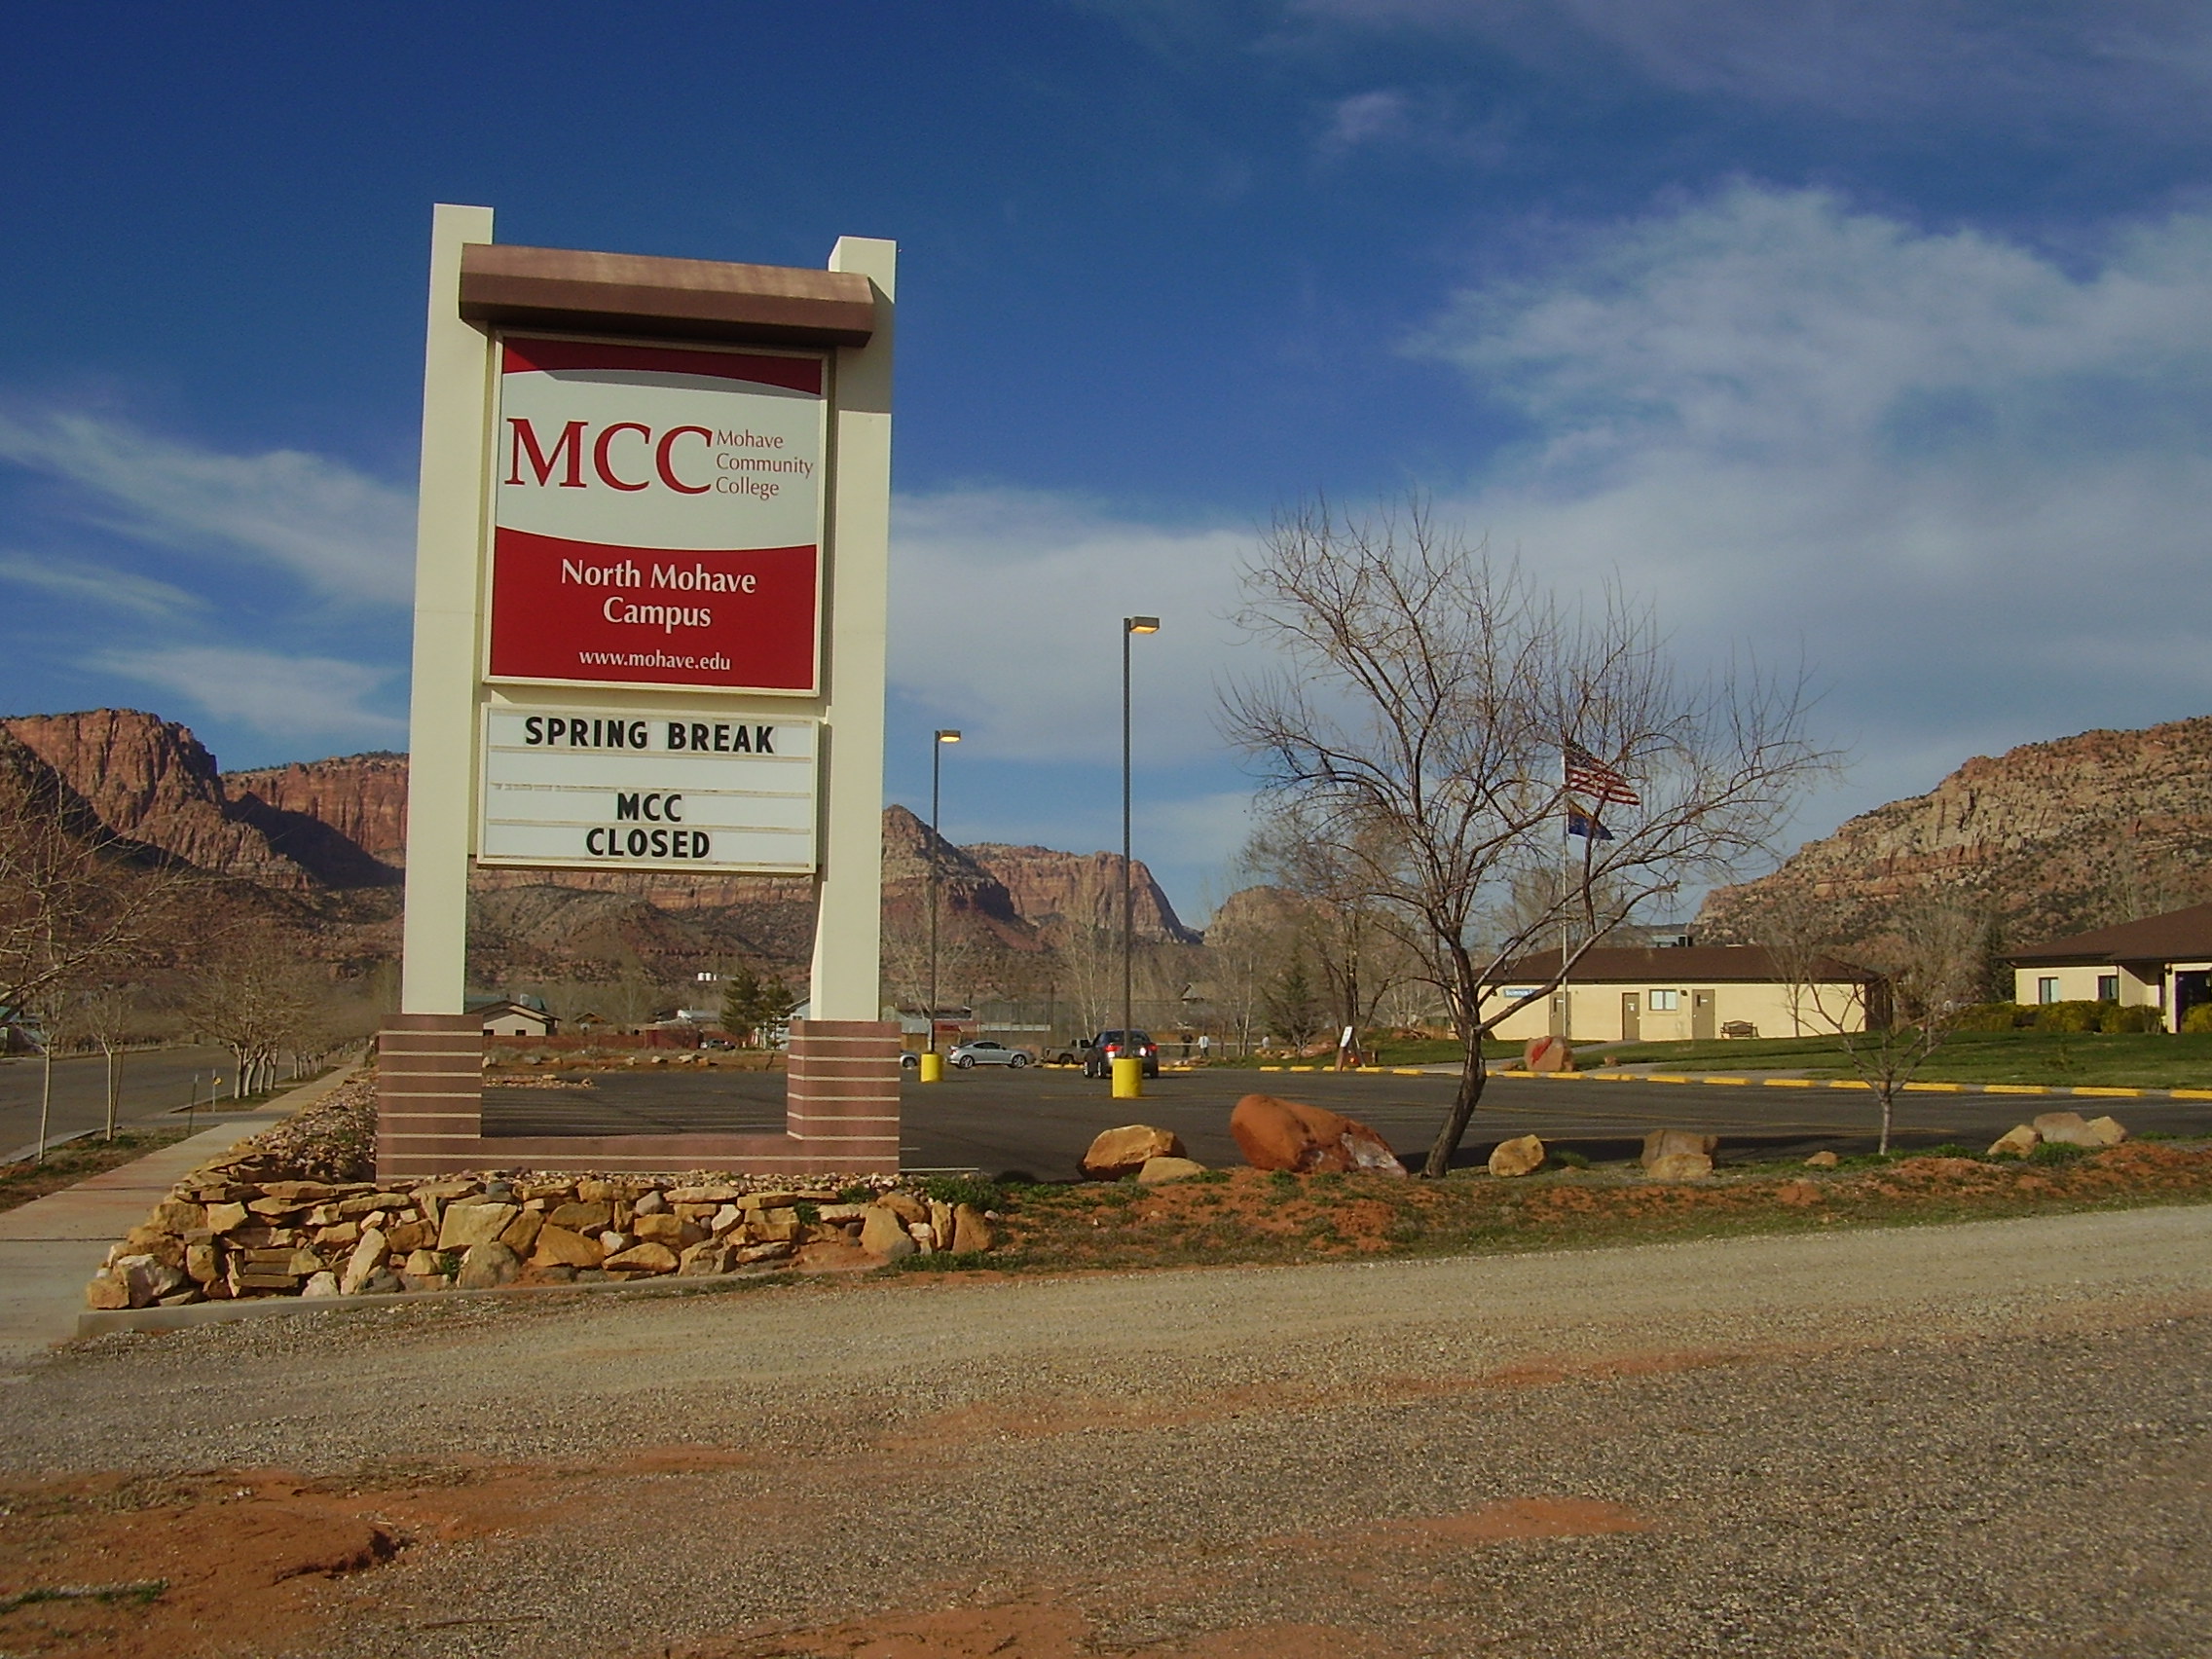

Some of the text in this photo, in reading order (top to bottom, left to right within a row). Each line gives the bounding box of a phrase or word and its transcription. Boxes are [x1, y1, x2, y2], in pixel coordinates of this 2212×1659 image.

[716, 429, 785, 450] Mohave
[503, 417, 714, 495] MCC
[716, 453, 814, 479] Community
[716, 476, 780, 501] College
[561, 558, 757, 594] North Mohave
[603, 596, 712, 634] Campus
[578, 649, 731, 672] www.mohave.edu
[524, 716, 775, 755] SPRING BREAK
[616, 793, 682, 823] MCC
[585, 828, 711, 859] CLOSED
